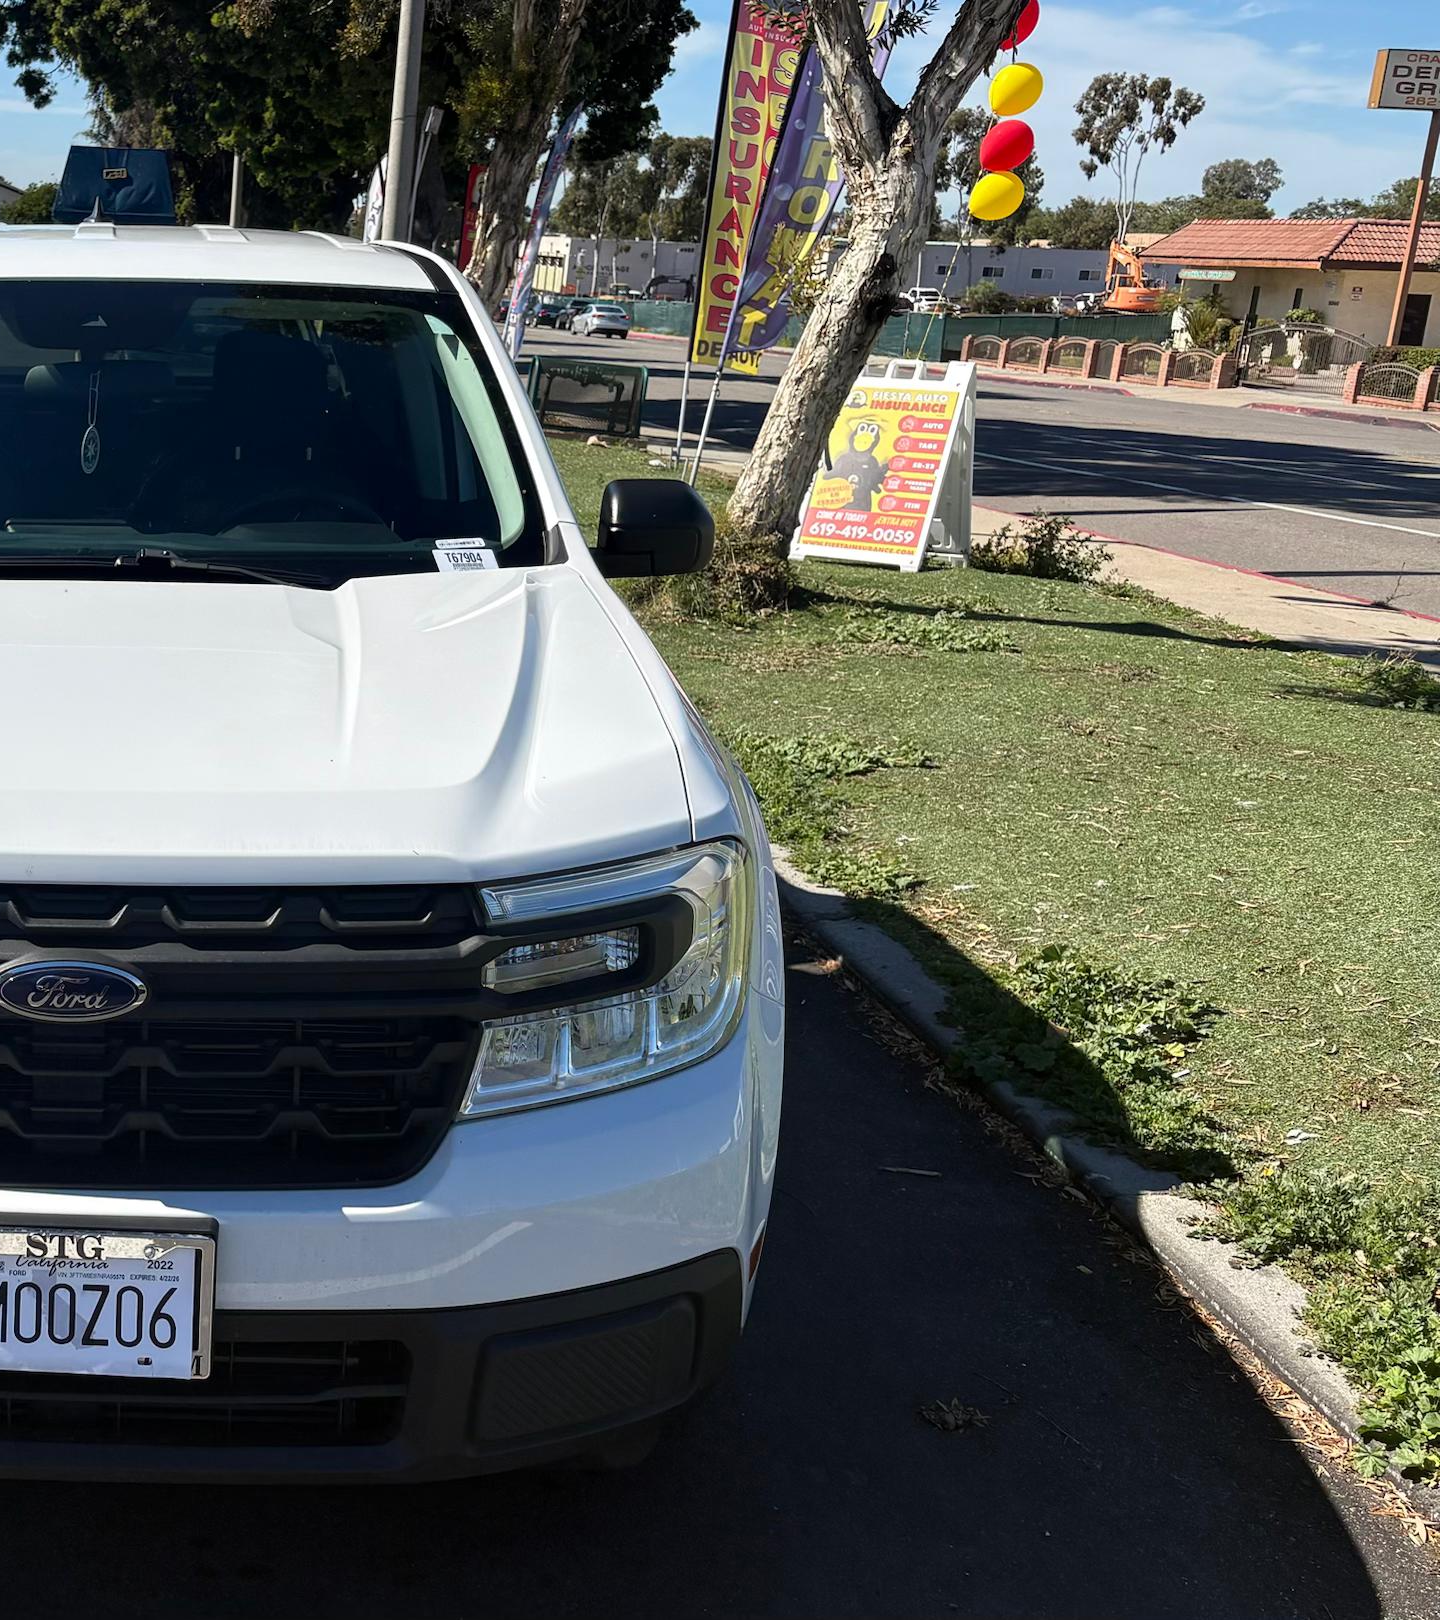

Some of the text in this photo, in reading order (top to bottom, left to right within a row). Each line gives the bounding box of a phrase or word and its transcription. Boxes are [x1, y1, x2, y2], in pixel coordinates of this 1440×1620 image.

[1395, 82, 1440, 95] GR
[706, 38, 766, 333] INSURANCE
[870, 400, 947, 413] INSURANCE
[872, 391, 949, 403] FIESTA AUTO
[809, 522, 915, 543] 619-419-0059
[444, 552, 483, 563] T67904
[27, 975, 109, 1009] Ford
[25, 1233, 105, 1260] STG
[16, 1254, 109, 1277] California
[147, 1259, 174, 1270] 2022
